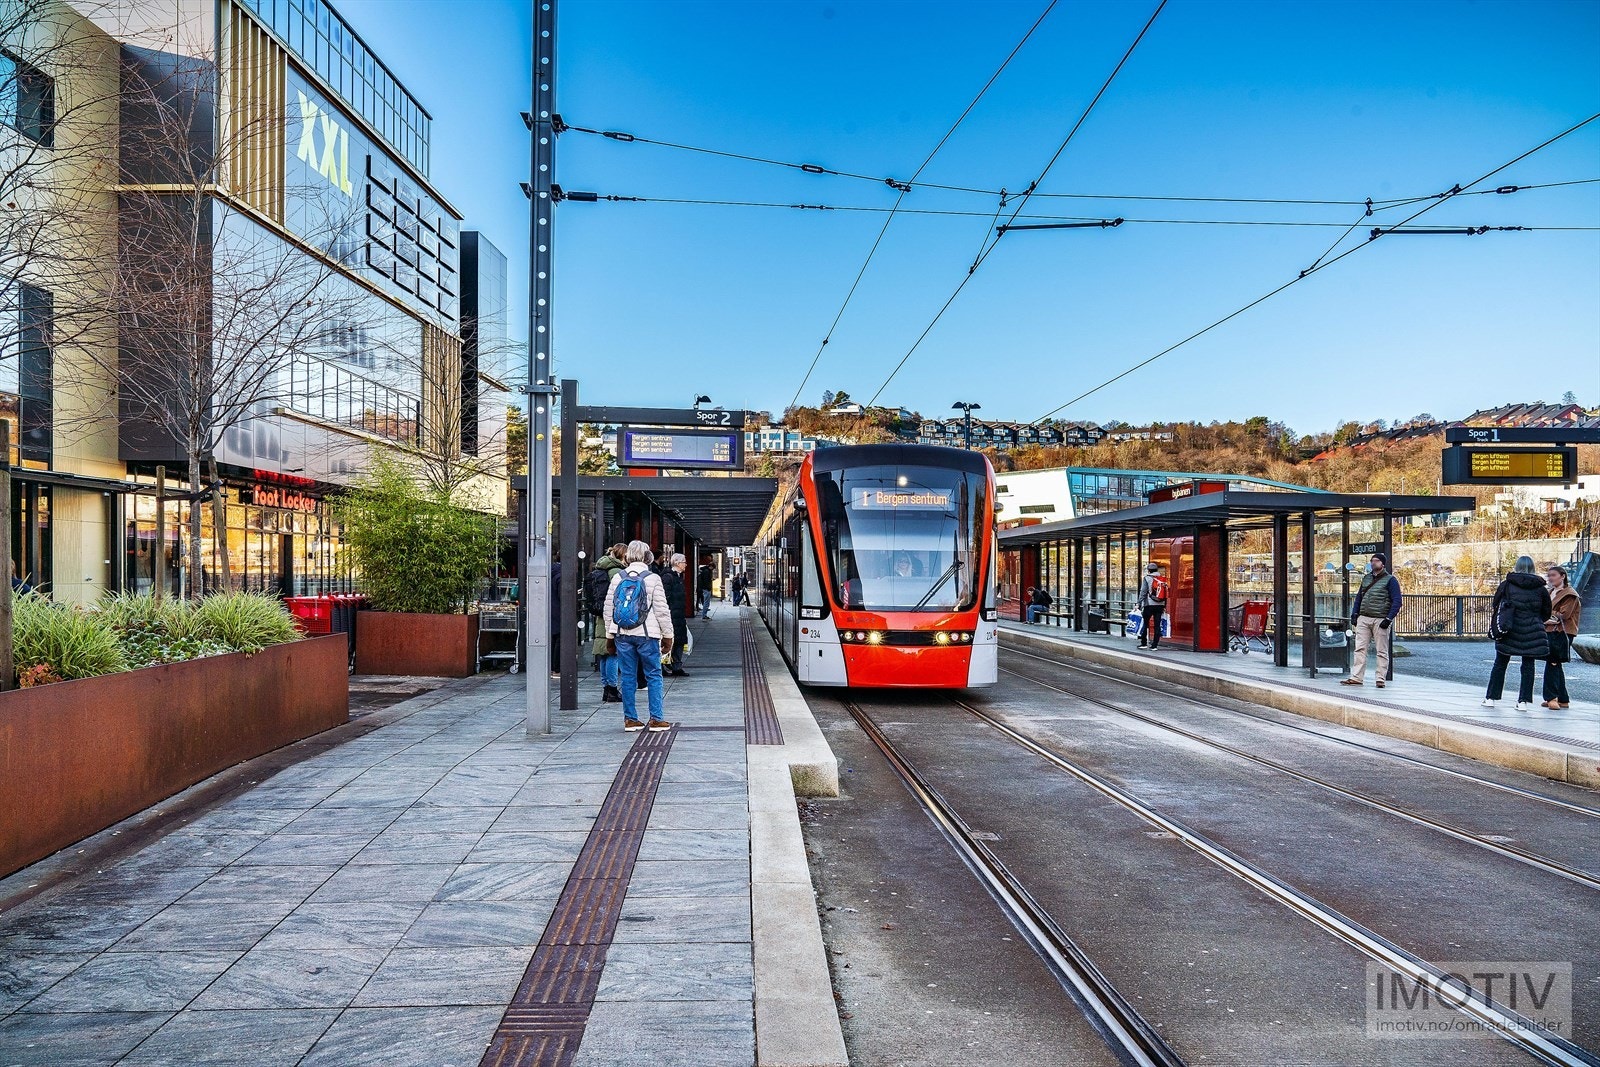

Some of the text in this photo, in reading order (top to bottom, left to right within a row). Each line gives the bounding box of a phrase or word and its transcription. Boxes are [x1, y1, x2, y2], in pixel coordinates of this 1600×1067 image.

[297, 89, 352, 198] XXL
[696, 411, 731, 426] Spor 2
[632, 434, 650, 442] Bergen
[1468, 428, 1501, 442] Spor 1
[282, 489, 316, 512] Locker
[862, 490, 948, 506] 1 Bergen sentrum
[1171, 488, 1191, 500] bybanen
[1352, 544, 1377, 555] Lagunen
[810, 629, 821, 639] 234
